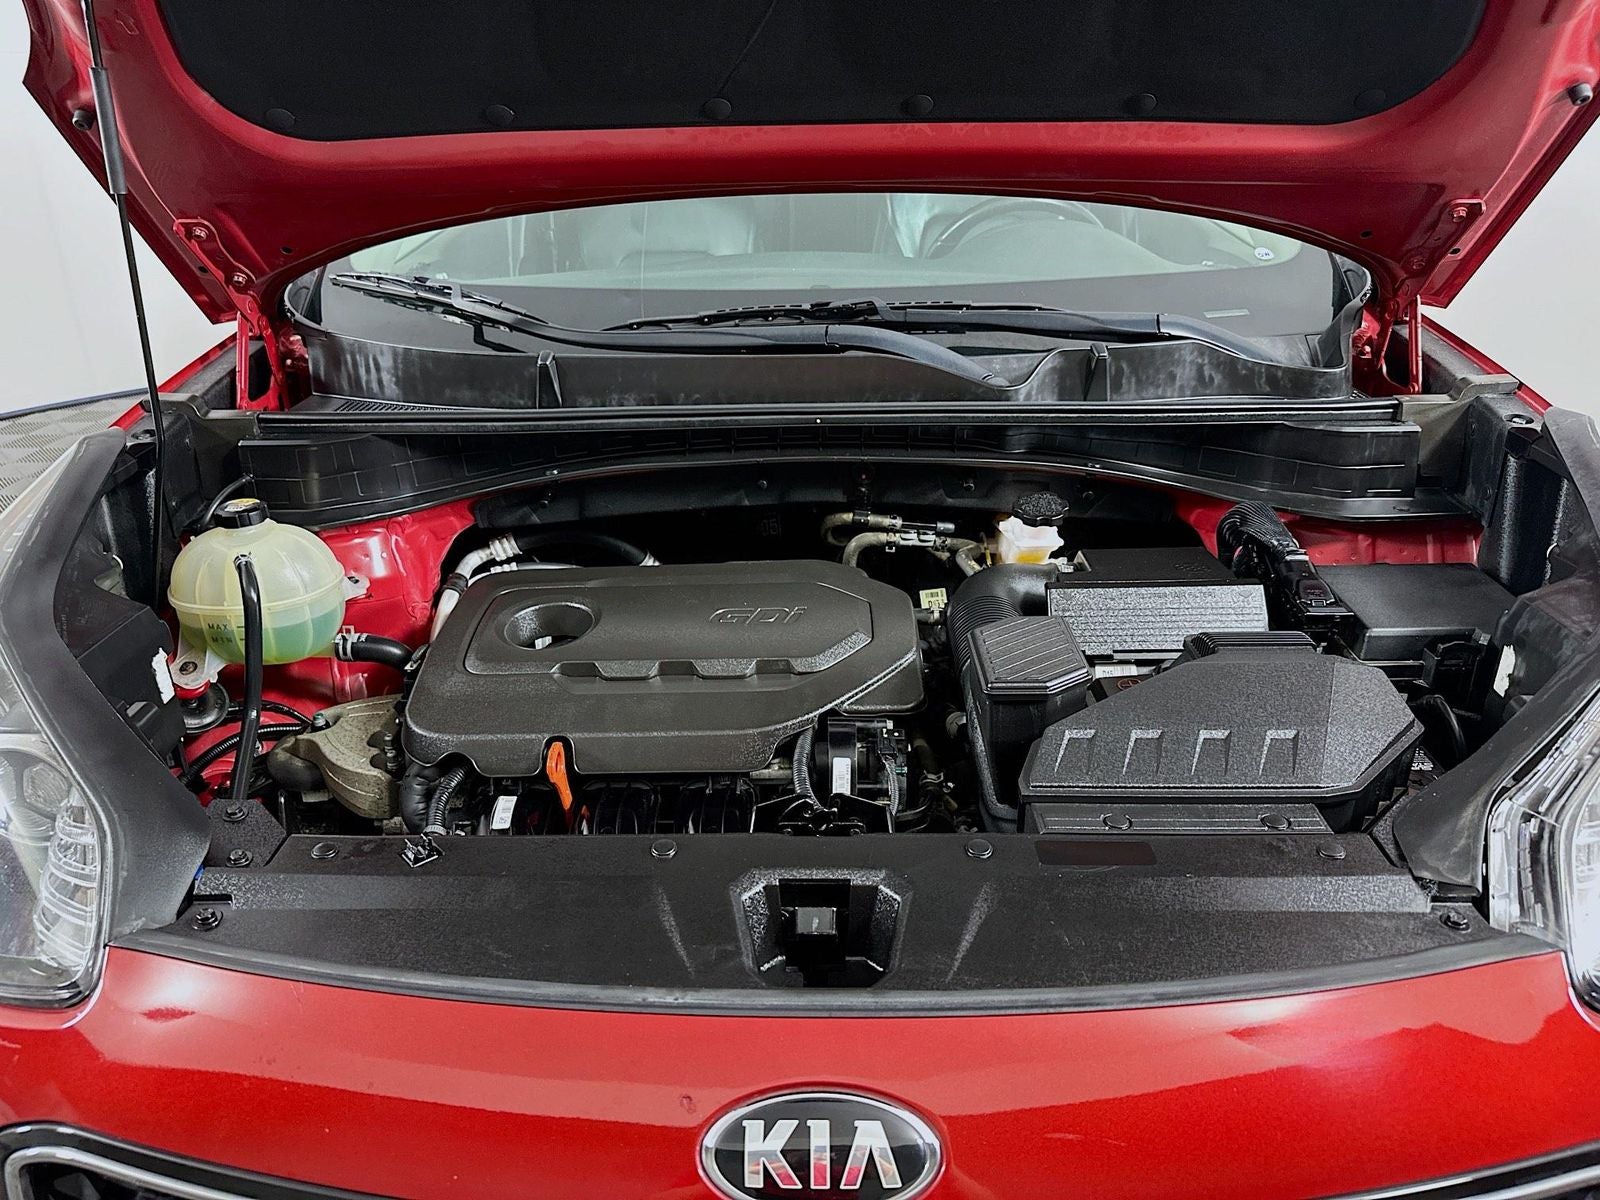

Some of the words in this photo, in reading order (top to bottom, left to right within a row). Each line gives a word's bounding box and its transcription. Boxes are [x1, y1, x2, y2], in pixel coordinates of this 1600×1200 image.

[207, 622, 228, 631] MAX
[211, 635, 233, 643] MIN
[742, 1119, 903, 1190] KIA
